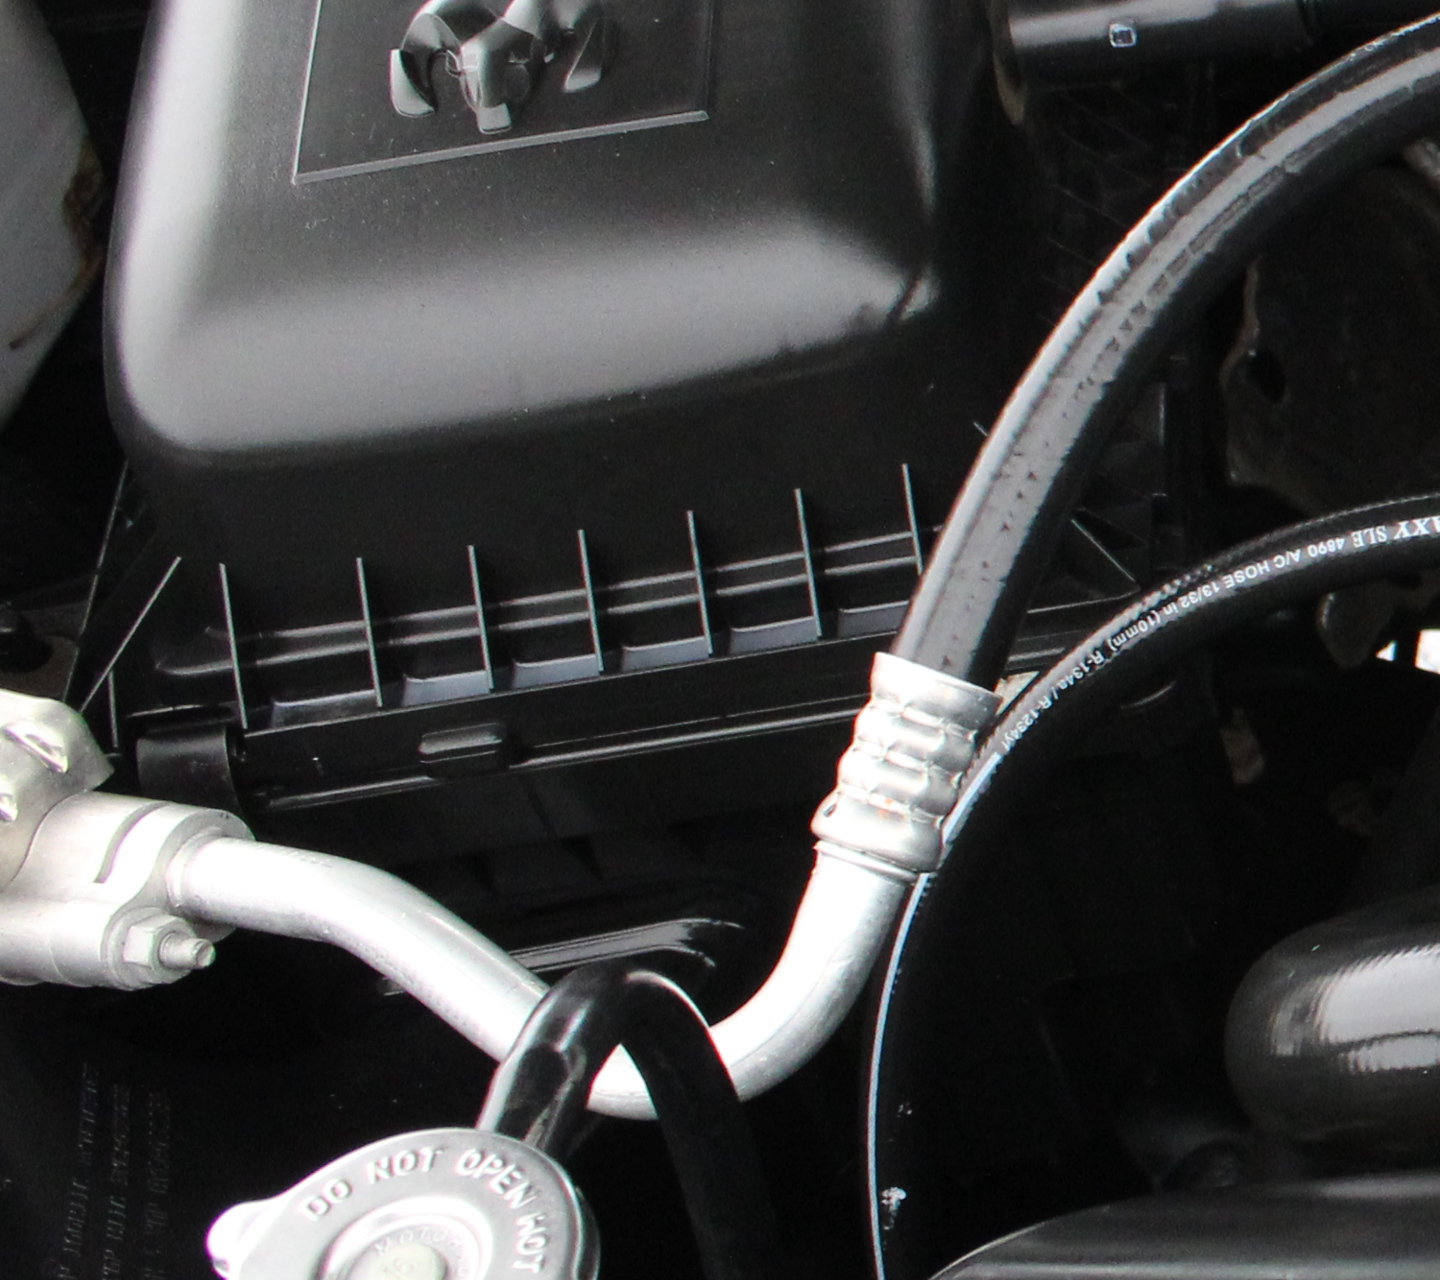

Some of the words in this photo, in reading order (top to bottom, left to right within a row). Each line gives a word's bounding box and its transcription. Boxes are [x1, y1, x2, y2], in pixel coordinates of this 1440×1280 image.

[1307, 536, 1346, 559] 4890
[1351, 524, 1388, 550] SLE
[1272, 548, 1302, 571] A/C
[1222, 559, 1271, 589] HOSE
[1178, 579, 1221, 610] 13/32
[1161, 602, 1178, 617] in
[1106, 607, 1160, 652] (10mm)
[299, 1176, 353, 1222] DO
[365, 1145, 448, 1185] NOT
[455, 1146, 540, 1210] OPEN
